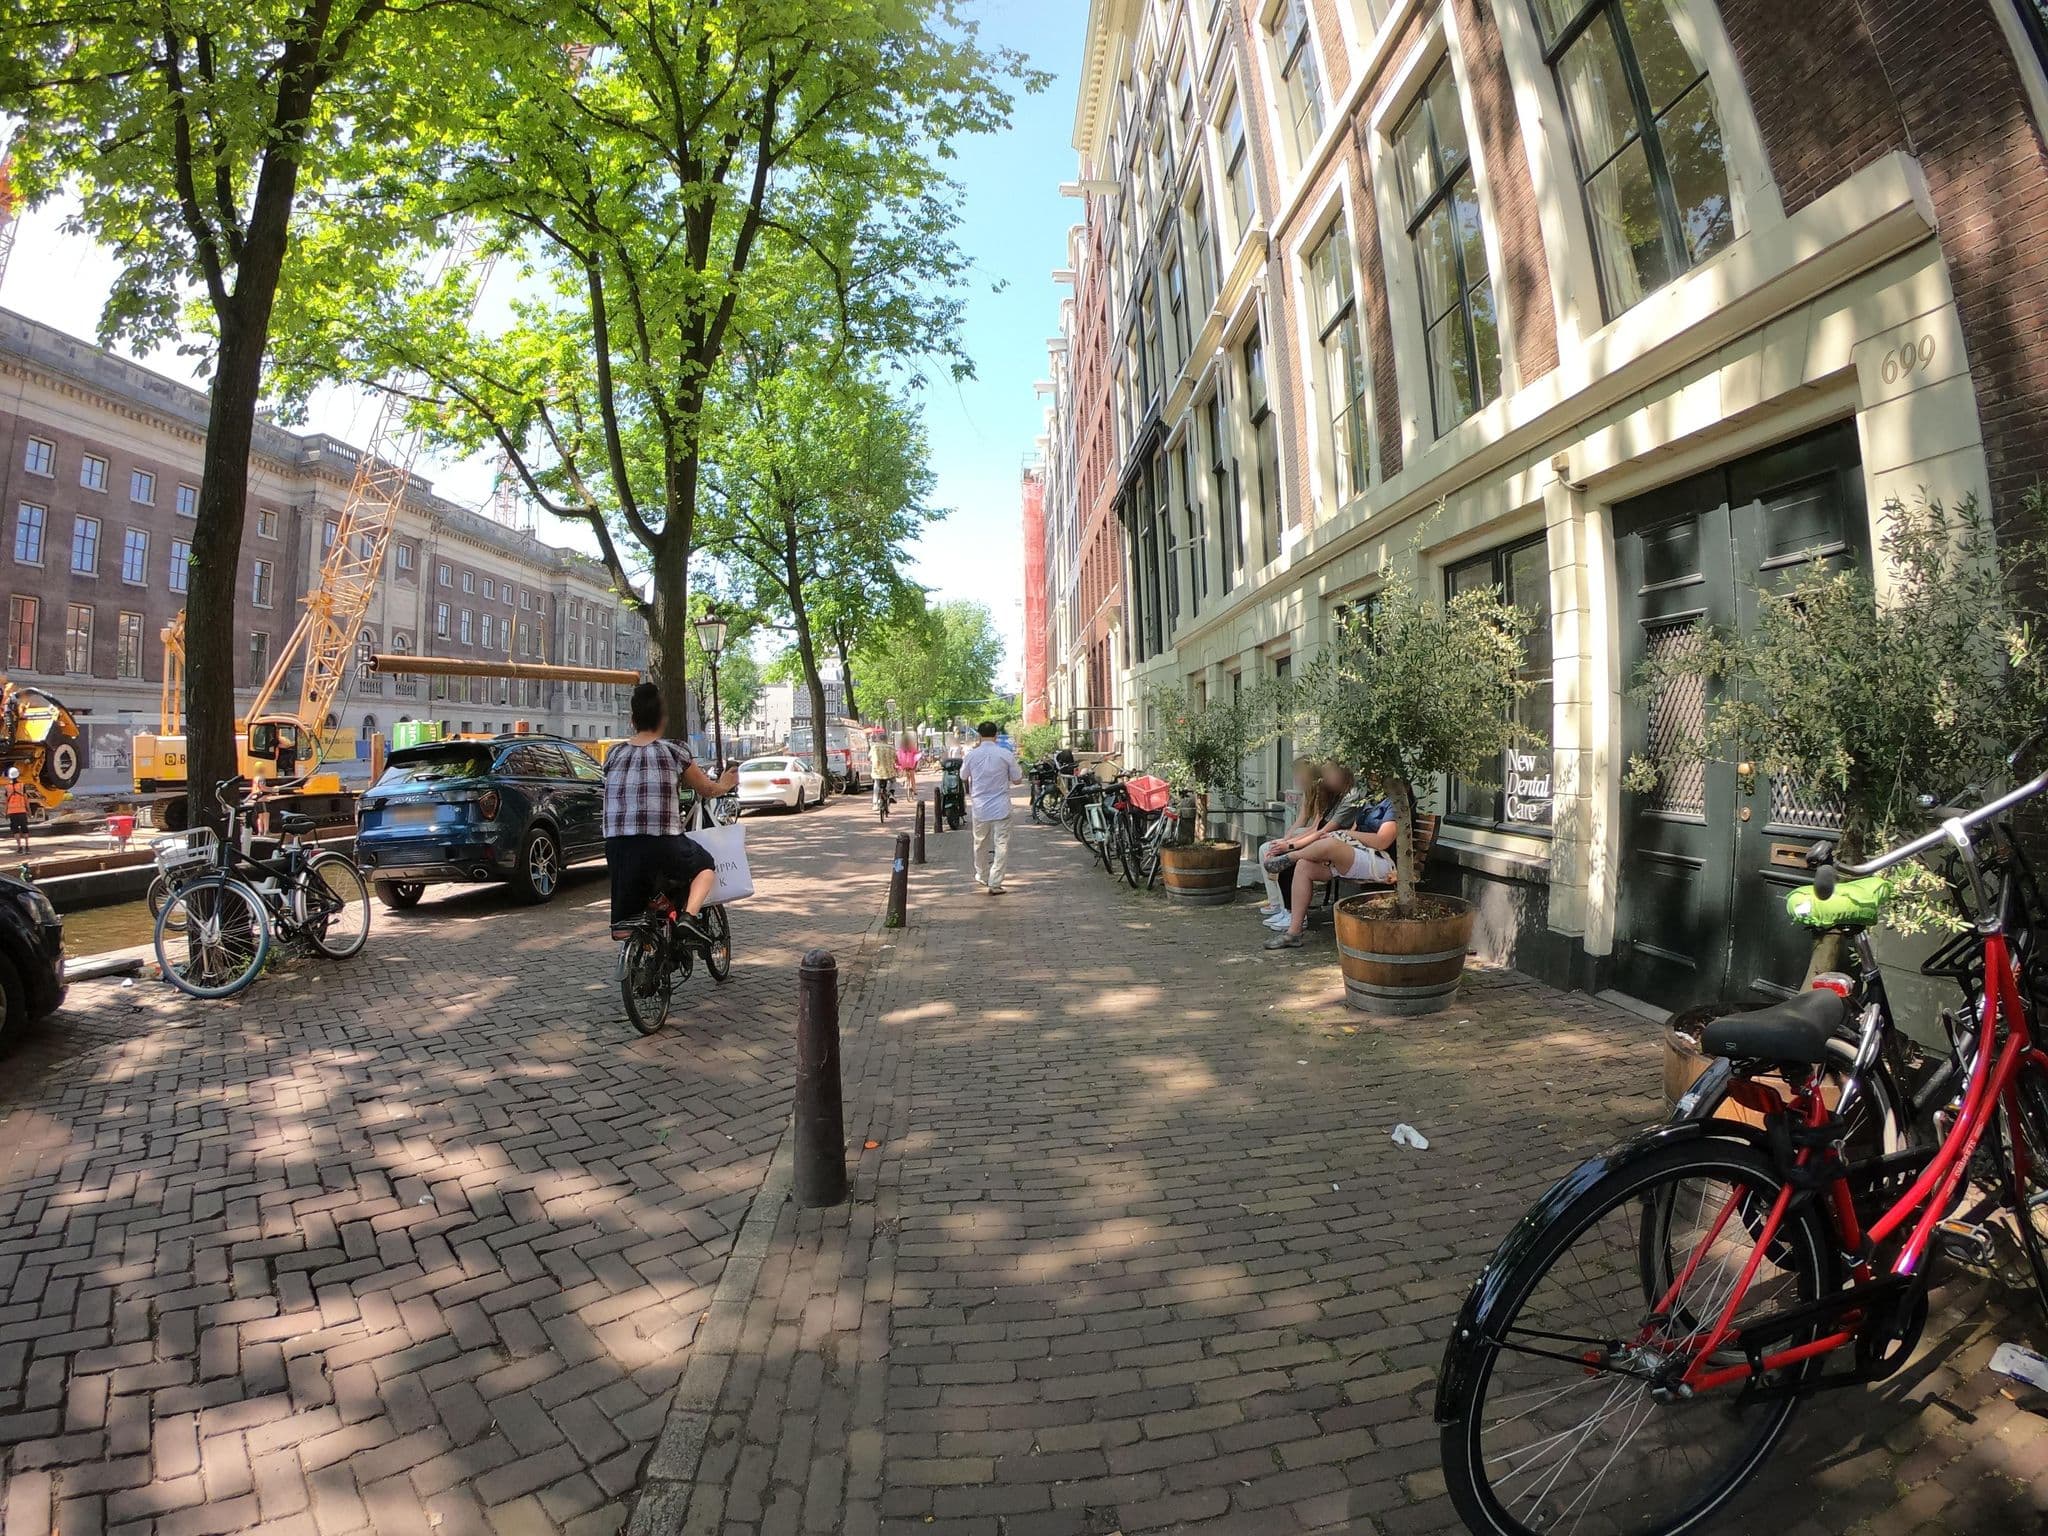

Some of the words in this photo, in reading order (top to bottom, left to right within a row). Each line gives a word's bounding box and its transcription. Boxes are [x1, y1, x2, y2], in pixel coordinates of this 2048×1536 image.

[1881, 334, 1936, 385] 699
[1508, 749, 1536, 772] New
[1507, 772, 1550, 797] Dental
[1507, 797, 1537, 820] Care
[715, 861, 738, 873] IPPA
[719, 878, 727, 888] K
